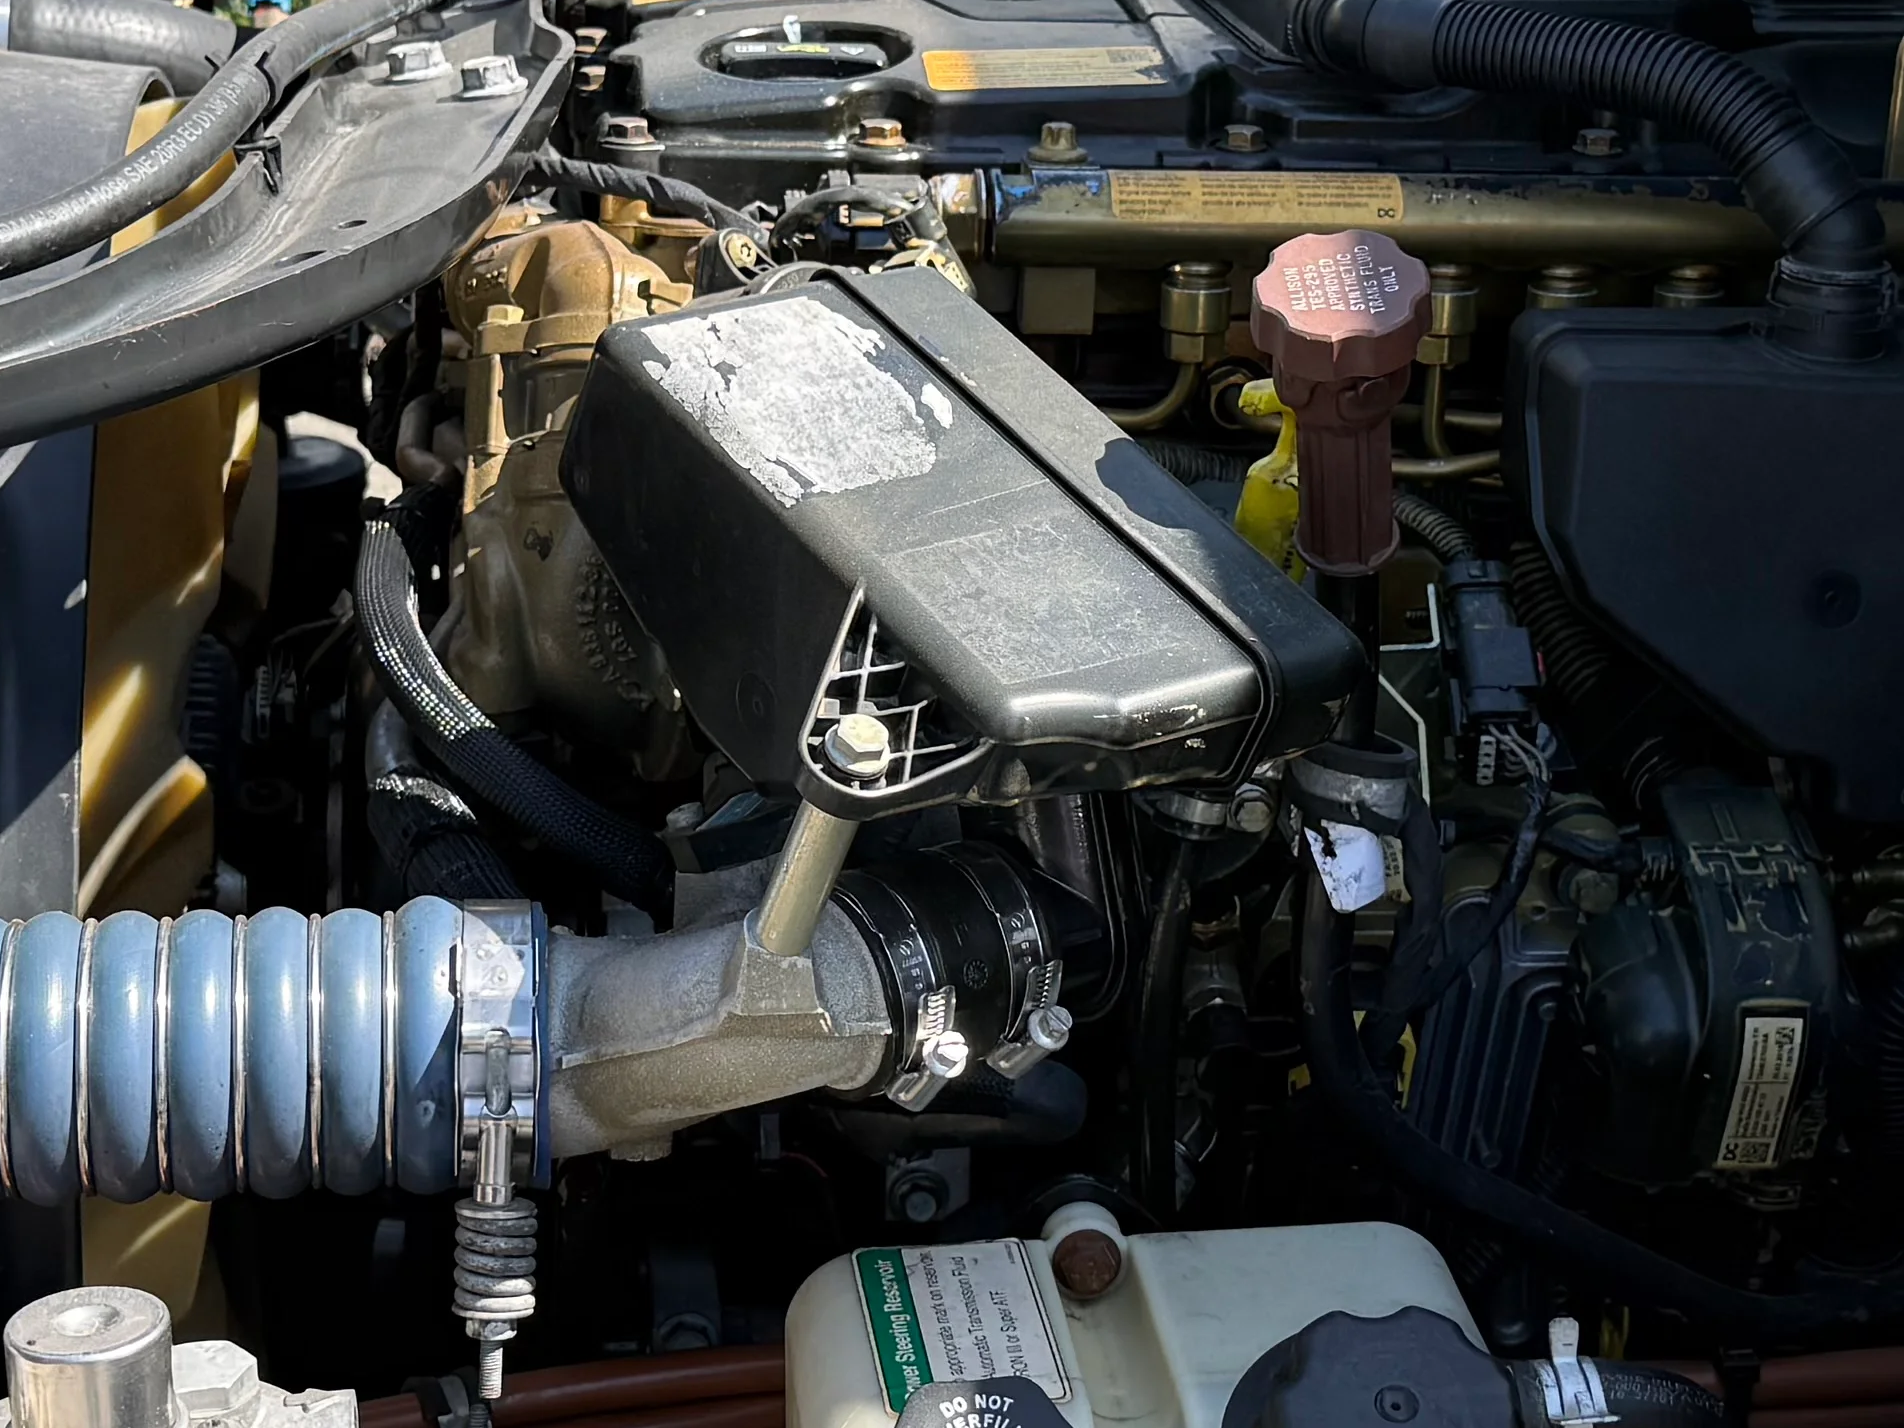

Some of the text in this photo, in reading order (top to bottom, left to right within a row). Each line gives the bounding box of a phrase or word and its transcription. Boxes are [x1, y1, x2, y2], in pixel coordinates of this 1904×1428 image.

[124, 155, 155, 184] SAE
[1283, 267, 1306, 311] ALLISON
[1302, 265, 1326, 311] TES-295
[1319, 259, 1345, 311] APPROVED
[1337, 254, 1364, 311] SYNTHETIC
[1354, 245, 1385, 314] TRANS FLUID
[1379, 266, 1398, 292] ONLY
[874, 1259, 903, 1312] Reservoir
[948, 1256, 969, 1276] Fluid
[931, 1289, 943, 1301] on
[931, 1302, 952, 1324] mark
[957, 1278, 984, 1333] Transmission
[888, 1314, 916, 1362] Steering
[998, 1307, 1019, 1332] Super
[938, 1393, 1014, 1419] DO NOT
